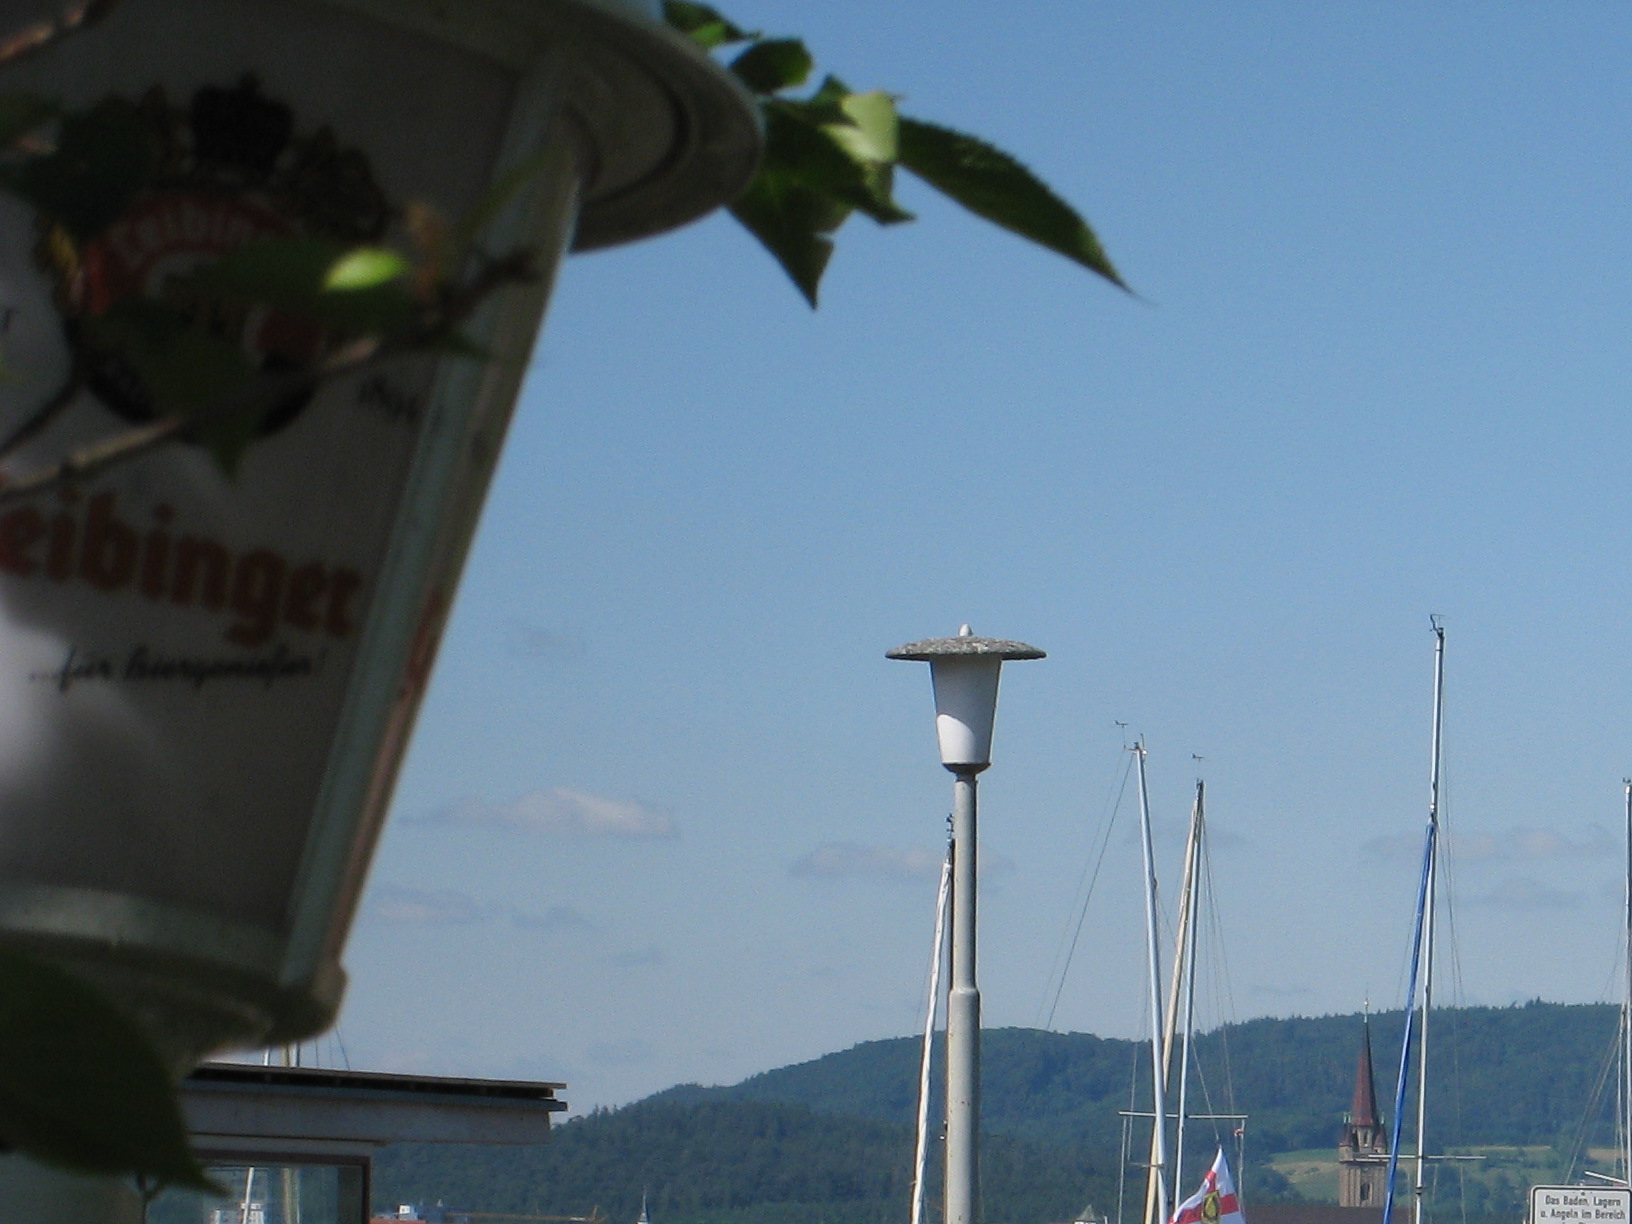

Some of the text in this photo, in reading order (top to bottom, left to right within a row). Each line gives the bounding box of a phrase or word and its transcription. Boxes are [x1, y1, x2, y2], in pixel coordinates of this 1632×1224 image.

[1545, 1195, 1560, 1206] Das
[1593, 1196, 1622, 1208] Lagern
[1540, 1208, 1626, 1220] u. Angeln im Bereich
